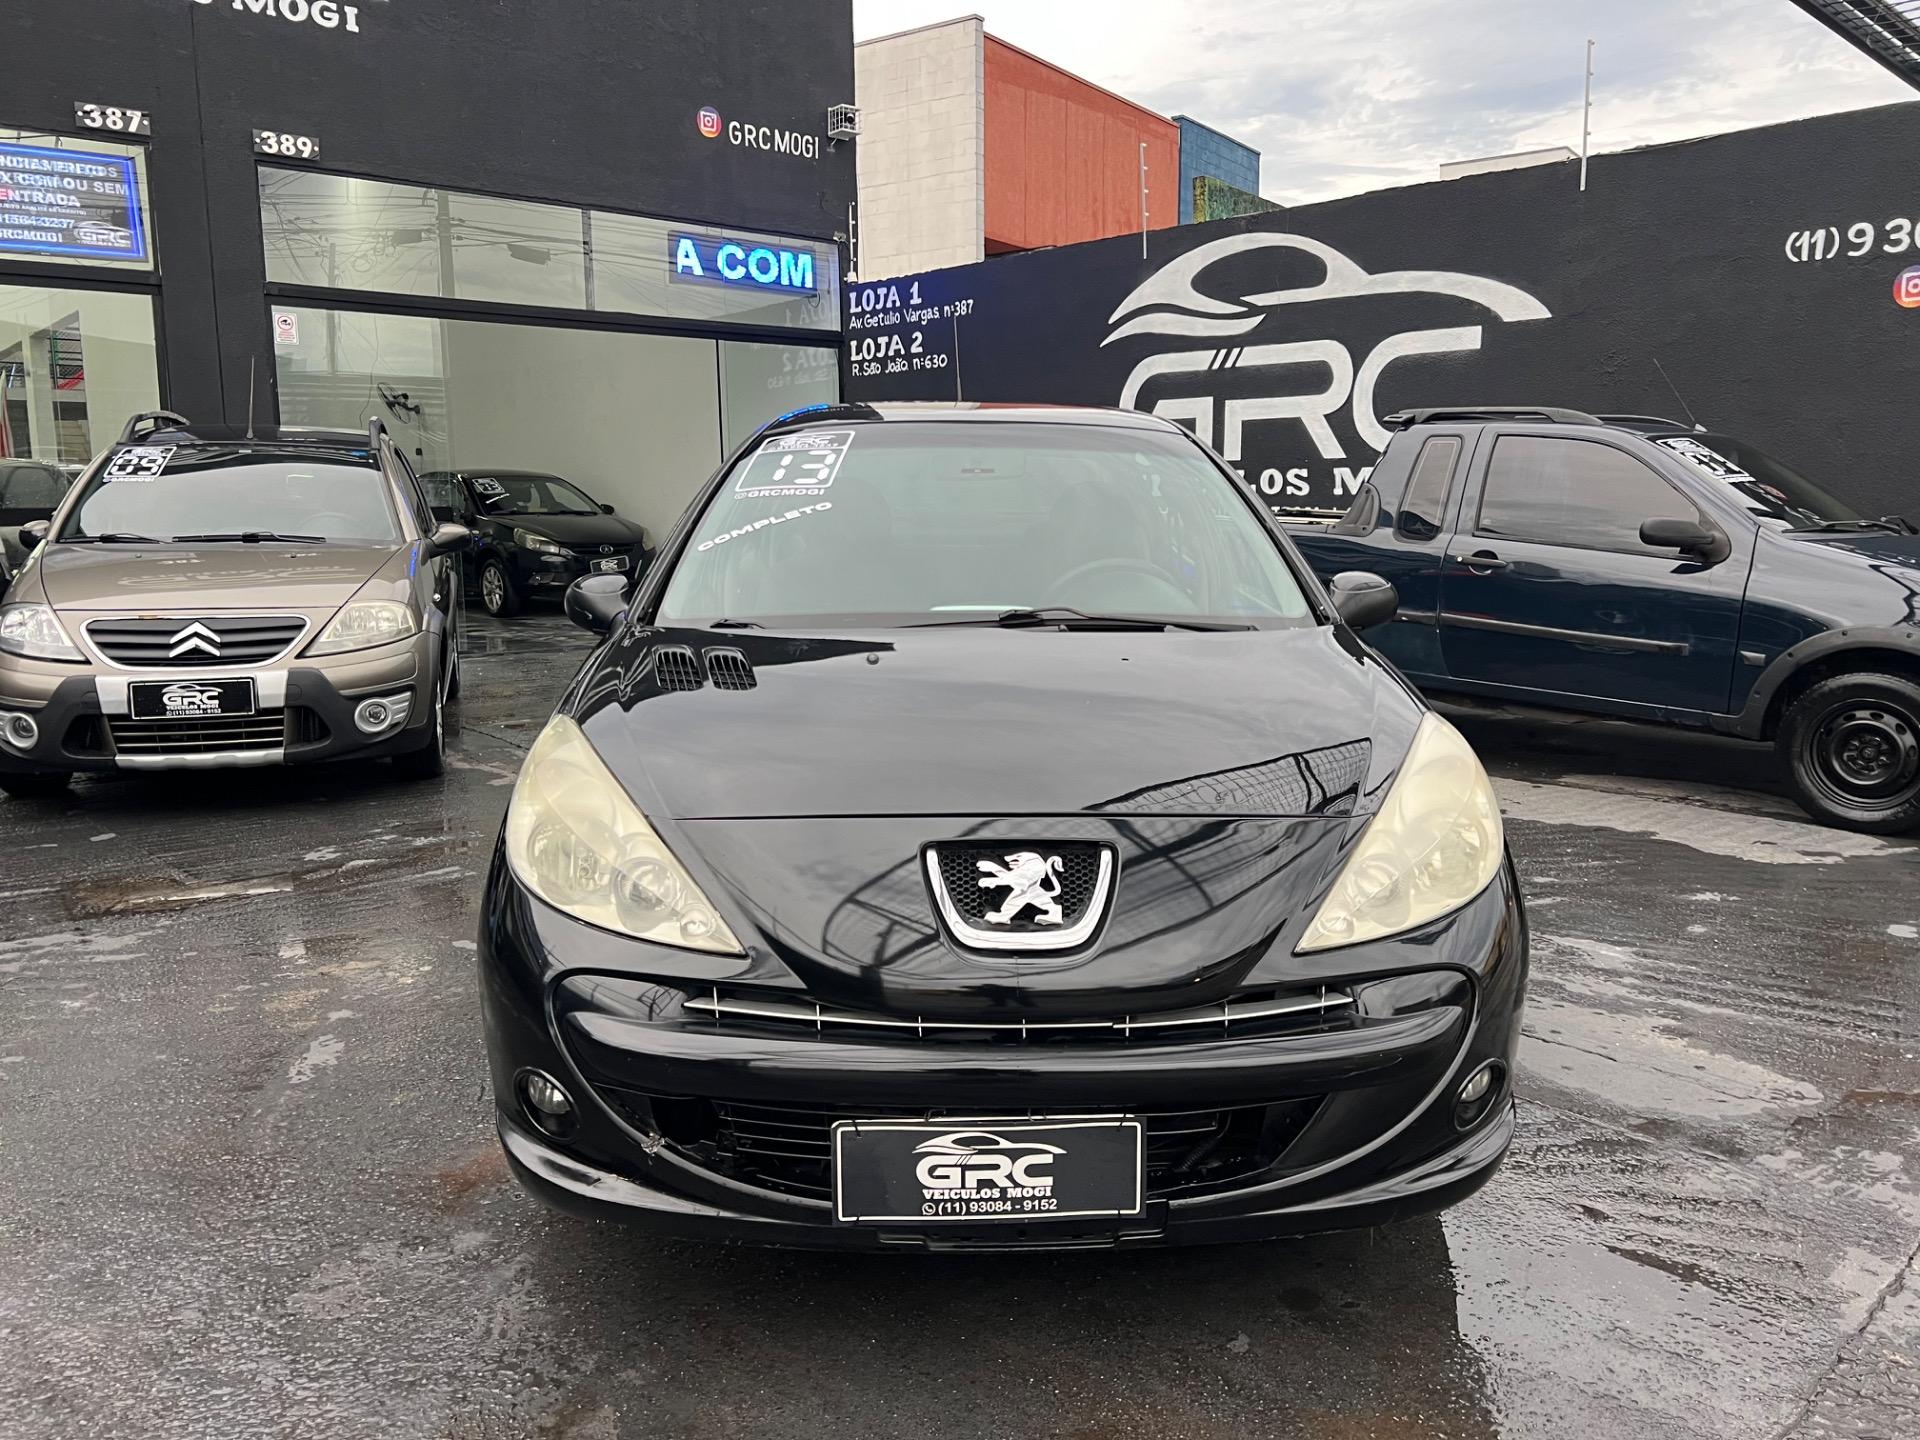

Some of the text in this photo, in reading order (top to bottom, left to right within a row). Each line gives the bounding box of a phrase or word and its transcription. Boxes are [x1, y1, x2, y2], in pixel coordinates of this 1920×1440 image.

[82, 103, 143, 133] 387
[260, 130, 314, 158] 389
[0, 187, 81, 208] ENTRADA
[63, 177, 88, 191] OU
[93, 181, 129, 196] SEM
[1785, 217, 1920, 262] (11)93
[677, 238, 814, 289] A COM
[849, 281, 922, 313] LOJA 1
[850, 331, 923, 361] LOJA 2
[1119, 325, 1482, 460] GRC
[110, 456, 164, 475] 09
[772, 450, 836, 484] 13
[697, 502, 832, 551] COMPLETO
[162, 691, 220, 706] GRC
[915, 1153, 1054, 1189] GRC
[922, 1186, 1052, 1200] VEICULOS MOGI
[938, 1201, 967, 1216] (11)
[969, 1200, 1012, 1213] 93084
[1023, 1198, 1058, 1211] 9152
